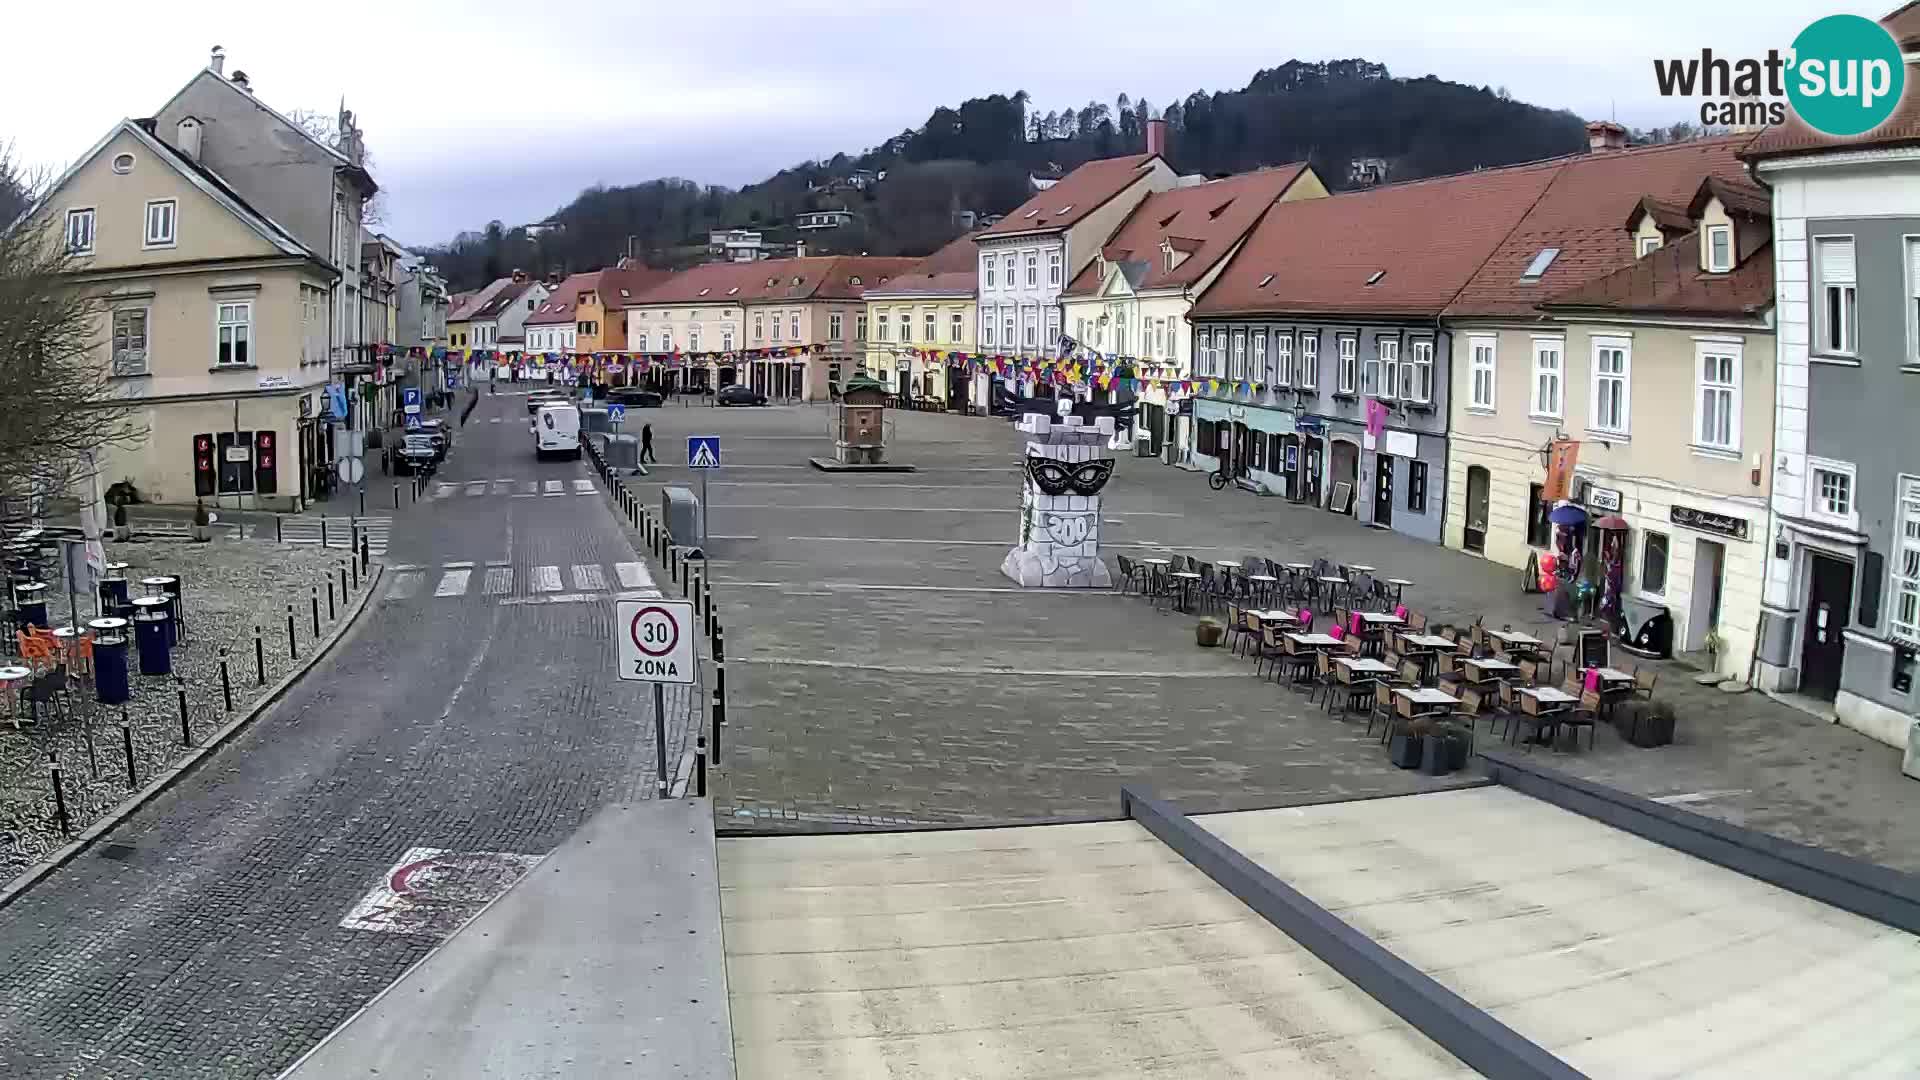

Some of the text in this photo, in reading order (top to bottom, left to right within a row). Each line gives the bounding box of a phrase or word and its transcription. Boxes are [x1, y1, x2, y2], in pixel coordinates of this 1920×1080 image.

[408, 391, 416, 403] P
[1048, 516, 1087, 545] 200
[644, 622, 668, 643] 30
[634, 659, 678, 677] ZONA
